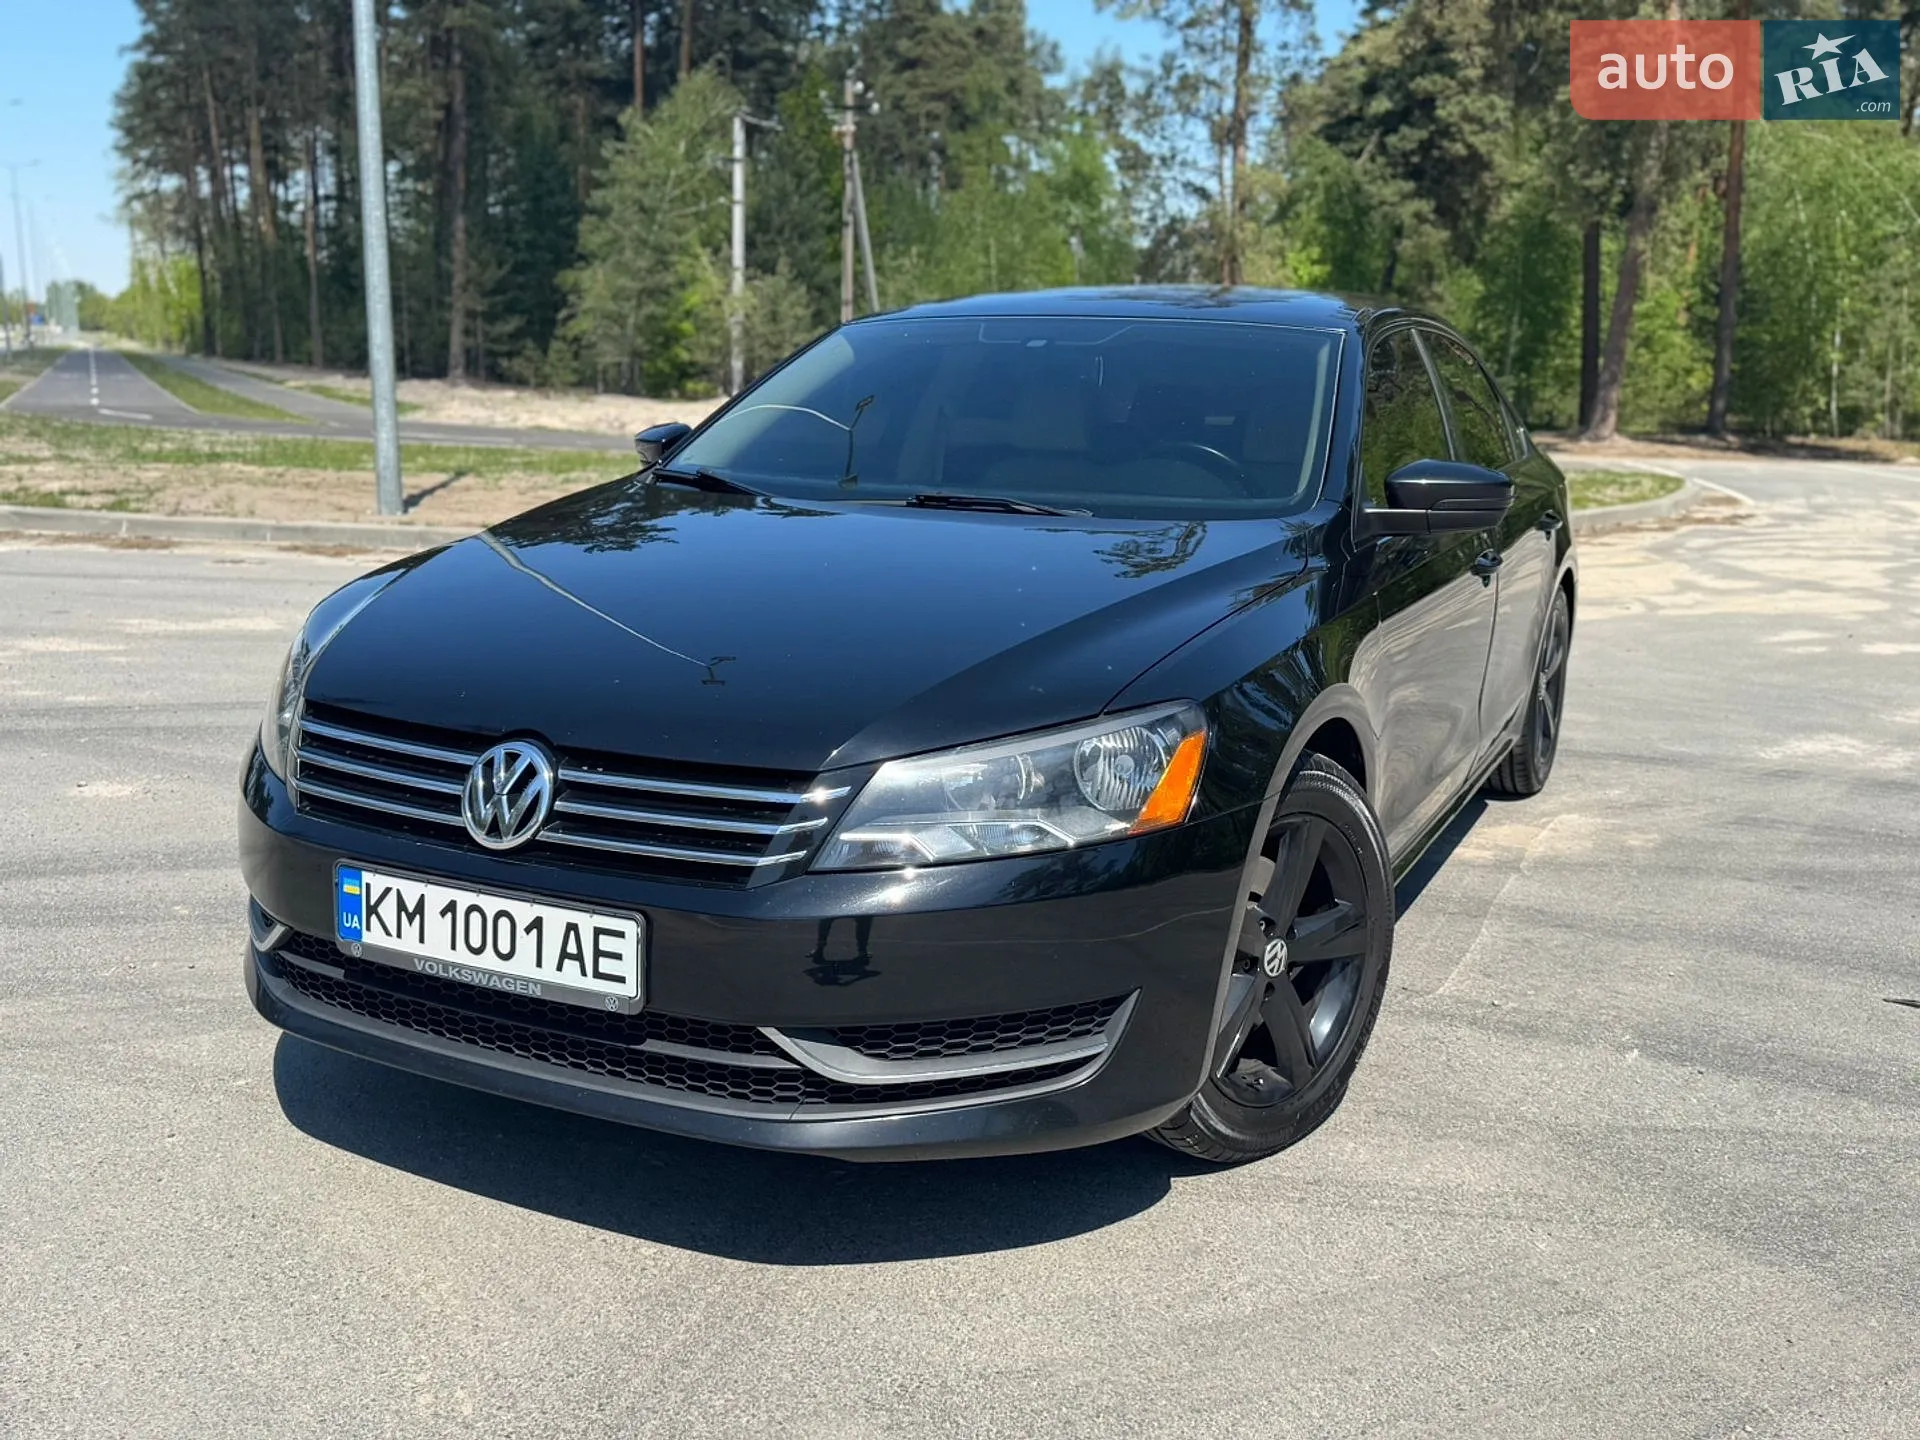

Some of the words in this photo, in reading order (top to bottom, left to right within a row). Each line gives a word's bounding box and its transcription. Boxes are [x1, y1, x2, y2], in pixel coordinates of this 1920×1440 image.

[343, 912, 361, 929] UA
[365, 882, 425, 945] KM
[439, 899, 543, 968] 1001
[556, 921, 627, 985] AE
[414, 958, 541, 996] VOLKSWAGEN
